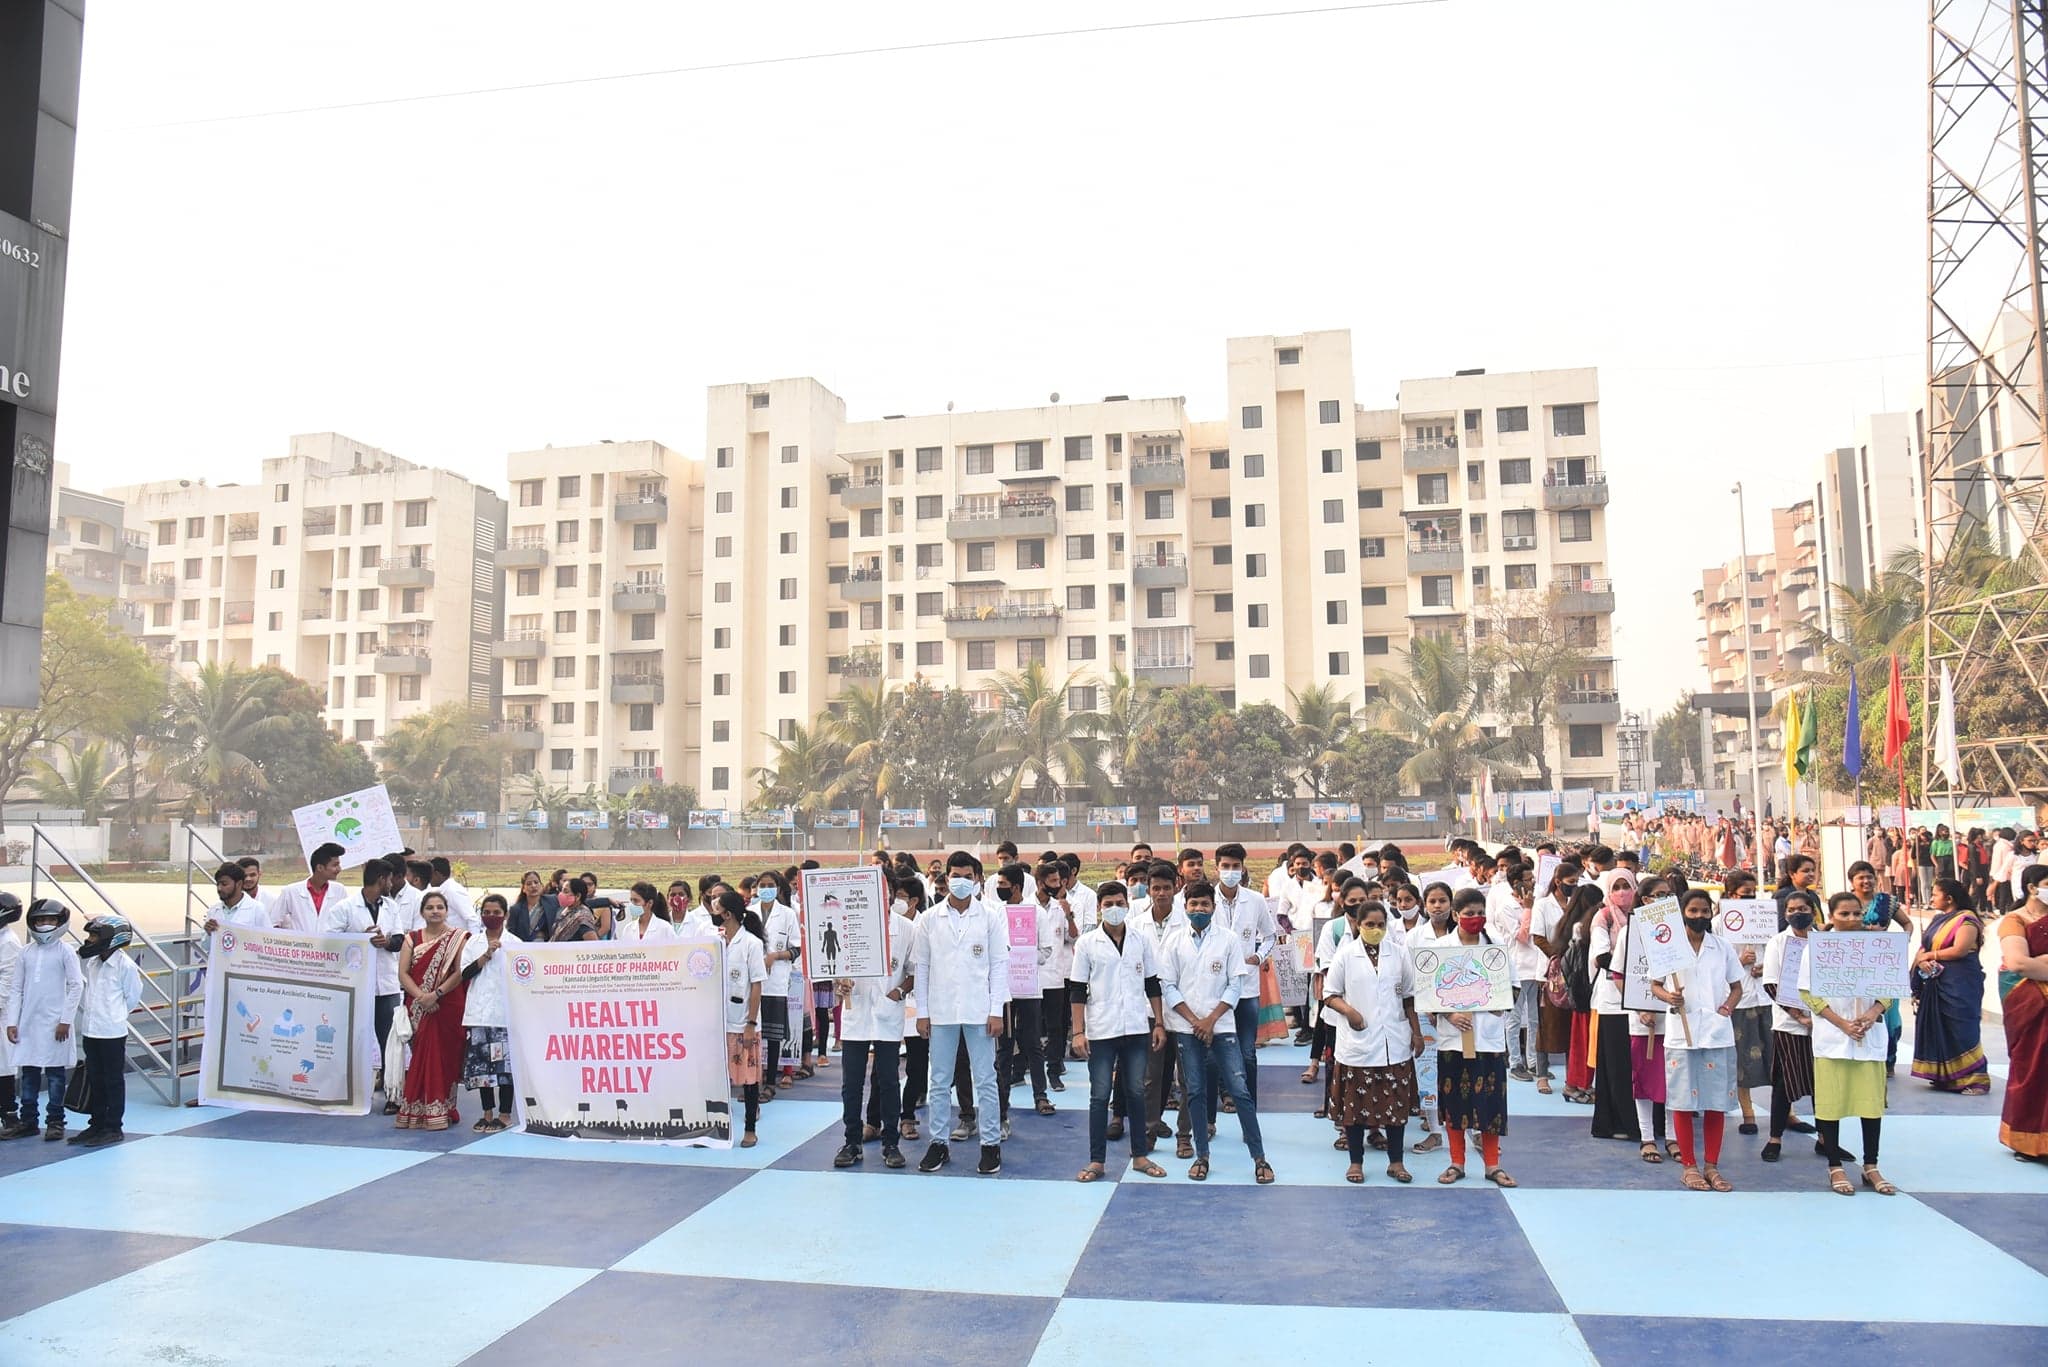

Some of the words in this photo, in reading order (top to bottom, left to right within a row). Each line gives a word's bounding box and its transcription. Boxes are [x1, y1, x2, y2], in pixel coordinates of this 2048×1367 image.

[264, 946, 290, 958] COLLEGE
[291, 949, 300, 959] OF
[301, 951, 341, 962] PHARMACY
[543, 963, 574, 976] SIDDHI
[576, 962, 614, 975] COLLEGE
[616, 962, 628, 974] OF
[629, 960, 680, 973] PHARMACY
[246, 985, 258, 993] How
[267, 987, 281, 995] Avoid
[568, 1000, 659, 1028] HEALTH
[545, 1033, 687, 1061] AWARENESS
[581, 1066, 653, 1093] RALLY
